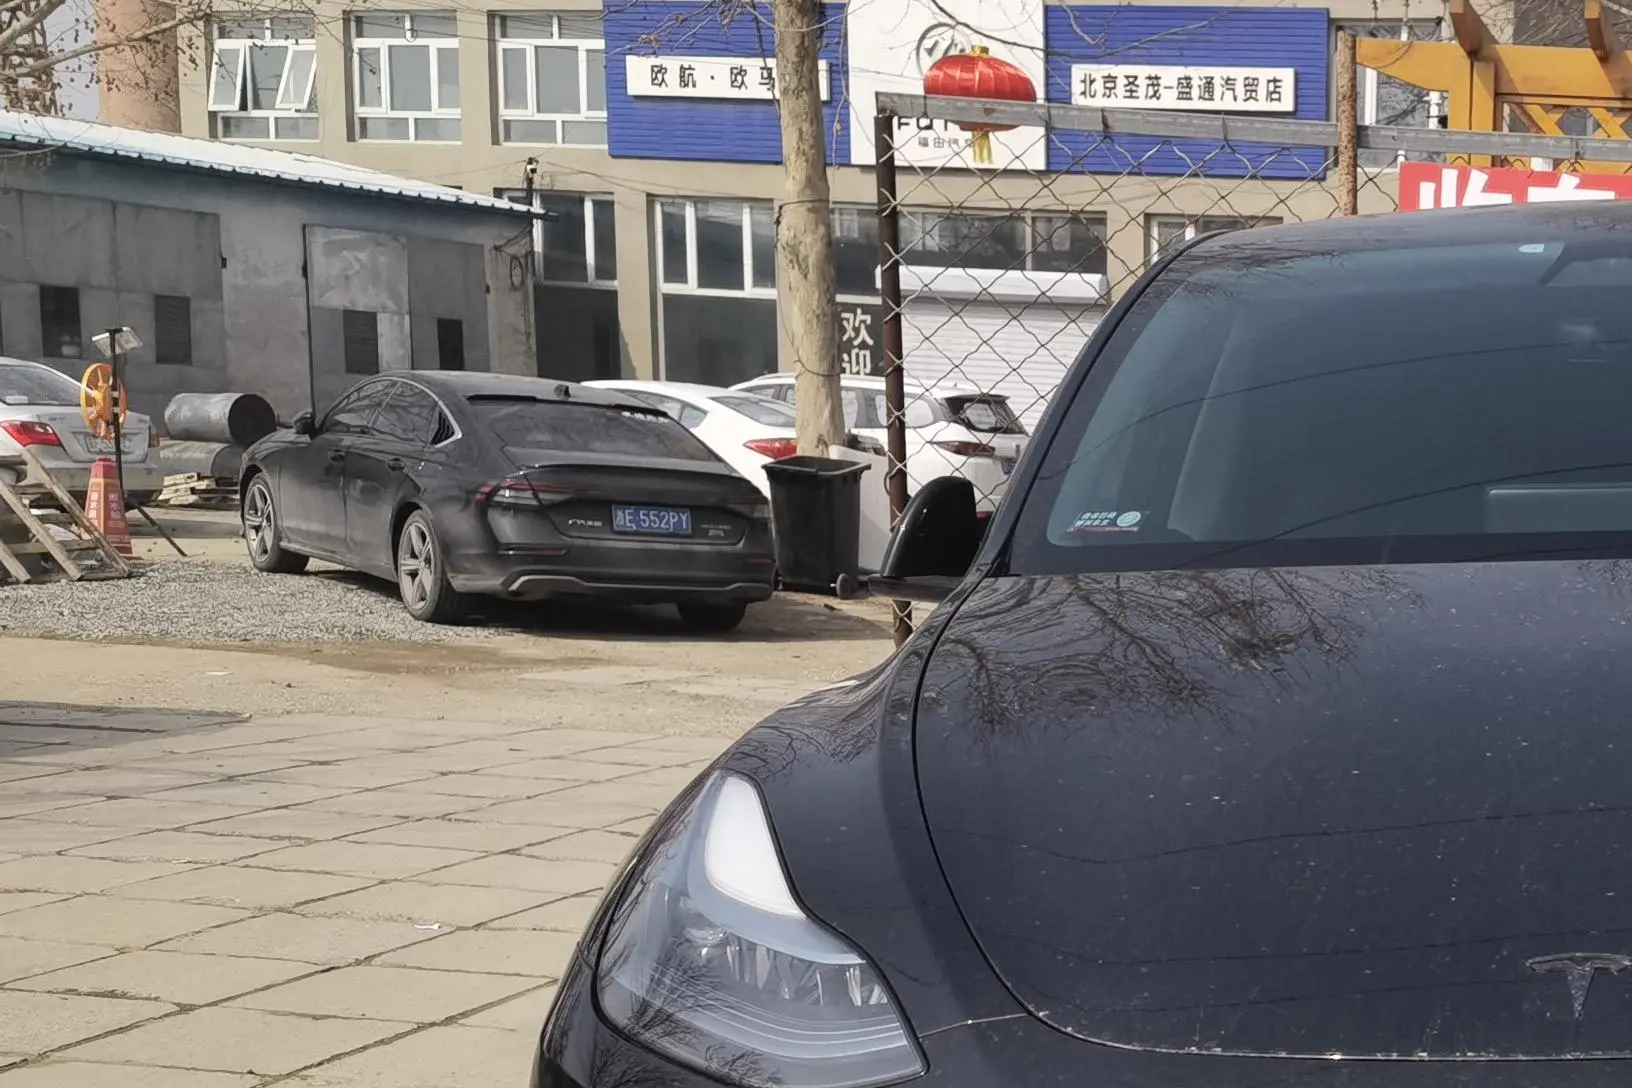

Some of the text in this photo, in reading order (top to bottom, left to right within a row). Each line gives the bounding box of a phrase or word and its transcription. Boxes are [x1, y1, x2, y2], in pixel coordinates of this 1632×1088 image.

[650, 63, 776, 91] 欧航·欧马
[1079, 72, 1284, 103] 北京圣茂-盛通汽贸店
[897, 116, 949, 131] FOT
[841, 308, 874, 376] 欢迎
